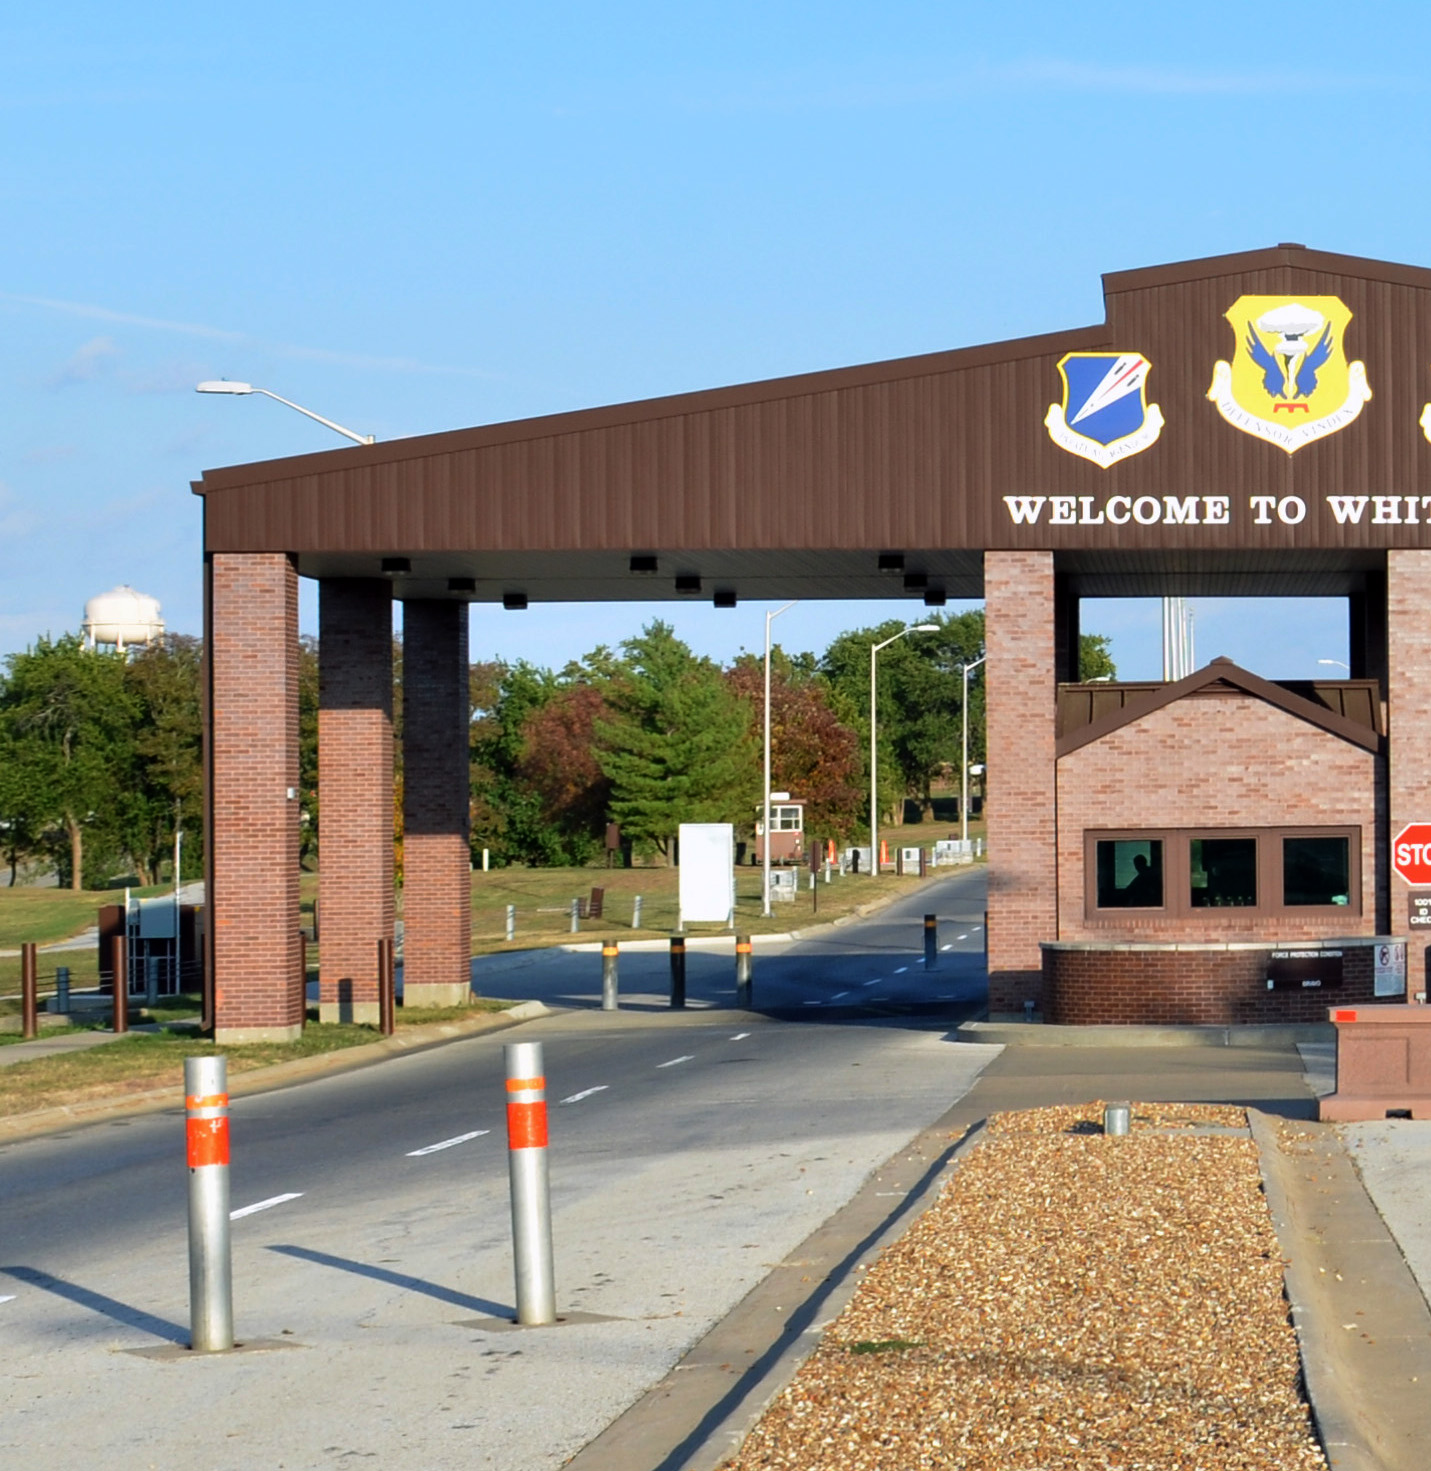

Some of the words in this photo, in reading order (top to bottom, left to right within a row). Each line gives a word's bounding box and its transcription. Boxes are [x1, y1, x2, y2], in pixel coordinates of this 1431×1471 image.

[1002, 495, 1230, 525] WELCOME
[1250, 495, 1307, 525] TO
[1419, 908, 1428, 916] ID
[1271, 951, 1289, 959] FORCE
